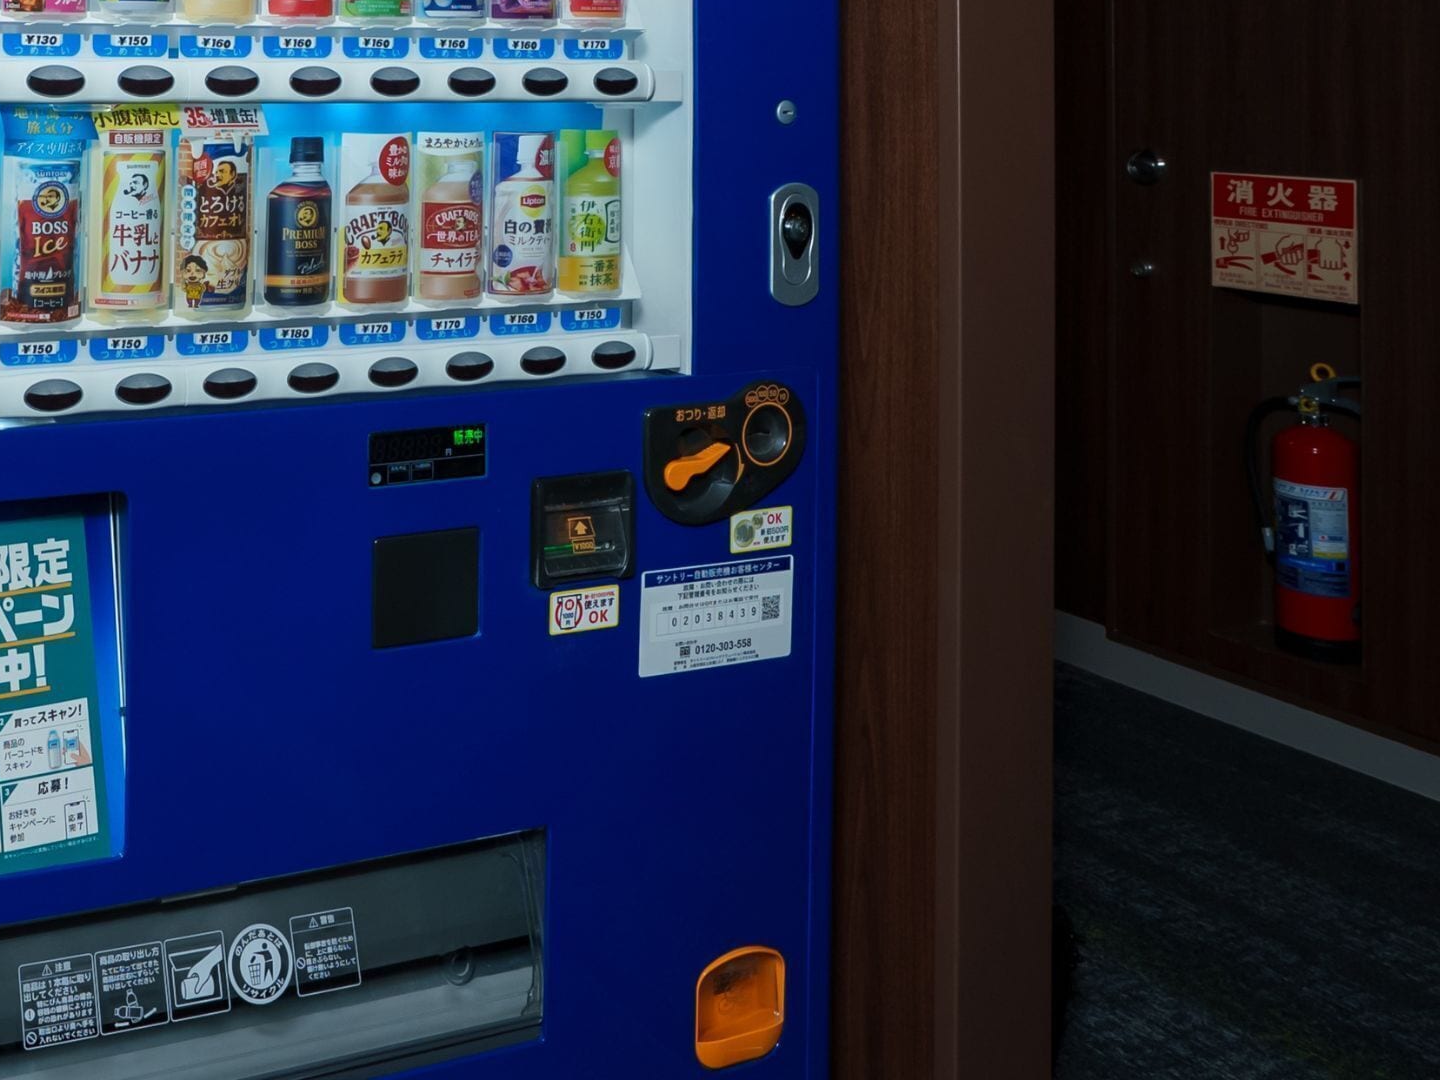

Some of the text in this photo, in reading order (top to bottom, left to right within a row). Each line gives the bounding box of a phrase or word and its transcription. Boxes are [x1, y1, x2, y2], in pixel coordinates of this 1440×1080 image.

[24, 34, 59, 46] ¥130
[116, 35, 150, 47] ¥150
[201, 36, 232, 49] ¥160
[283, 37, 314, 49] ¥160
[361, 38, 391, 50] ¥160
[437, 38, 466, 50] ¥160
[511, 39, 539, 51] ¥160
[582, 40, 607, 50] ¥170
[94, 108, 181, 127] 小腹満たし
[114, 132, 162, 144] 自販機限定
[521, 196, 546, 207] Lipton
[1226, 178, 1339, 213] 消火器
[199, 195, 246, 213] とろける
[115, 209, 159, 221] コーヒー香る
[1239, 205, 1258, 218] FIRE
[32, 220, 69, 235] BOSS
[580, 199, 597, 253] 伊右衛門
[112, 223, 160, 248] 牛乳と
[282, 227, 326, 242] PREMIUM
[34, 235, 68, 258] Ice
[294, 240, 318, 250] BOSS
[110, 249, 160, 276] バナナ
[361, 250, 404, 265] カフェラテ
[430, 252, 480, 269] チャイラテ
[509, 313, 535, 325] ¥160
[578, 309, 603, 320] ¥150
[361, 323, 390, 335] ¥170
[434, 318, 462, 331] ¥170
[198, 332, 229, 345] ¥150
[280, 327, 310, 340] ¥180
[20, 342, 54, 356] ¥150
[110, 336, 144, 350] ¥150
[453, 427, 483, 445] 販売中
[767, 512, 783, 525] OK
[584, 597, 616, 610] 使えます
[589, 609, 609, 624] OK
[694, 638, 753, 656] 0120-303-558
[13, 704, 83, 729] 買ってスキャン!
[2, 737, 26, 750] 商品の
[3, 745, 44, 762] バーコードを
[4, 759, 33, 773] スキャン
[36, 776, 70, 796] 応募!
[7, 807, 38, 821] お好きな
[67, 811, 84, 823] 応募
[8, 815, 57, 832] キャンペーンに
[68, 821, 85, 833] 完了
[9, 832, 26, 844] 参加
[98, 946, 160, 966] 商品の取り出し方
[54, 960, 73, 973] 注意
[23, 985, 79, 1003] 出してください
[38, 1027, 96, 1045] 入れないでください
